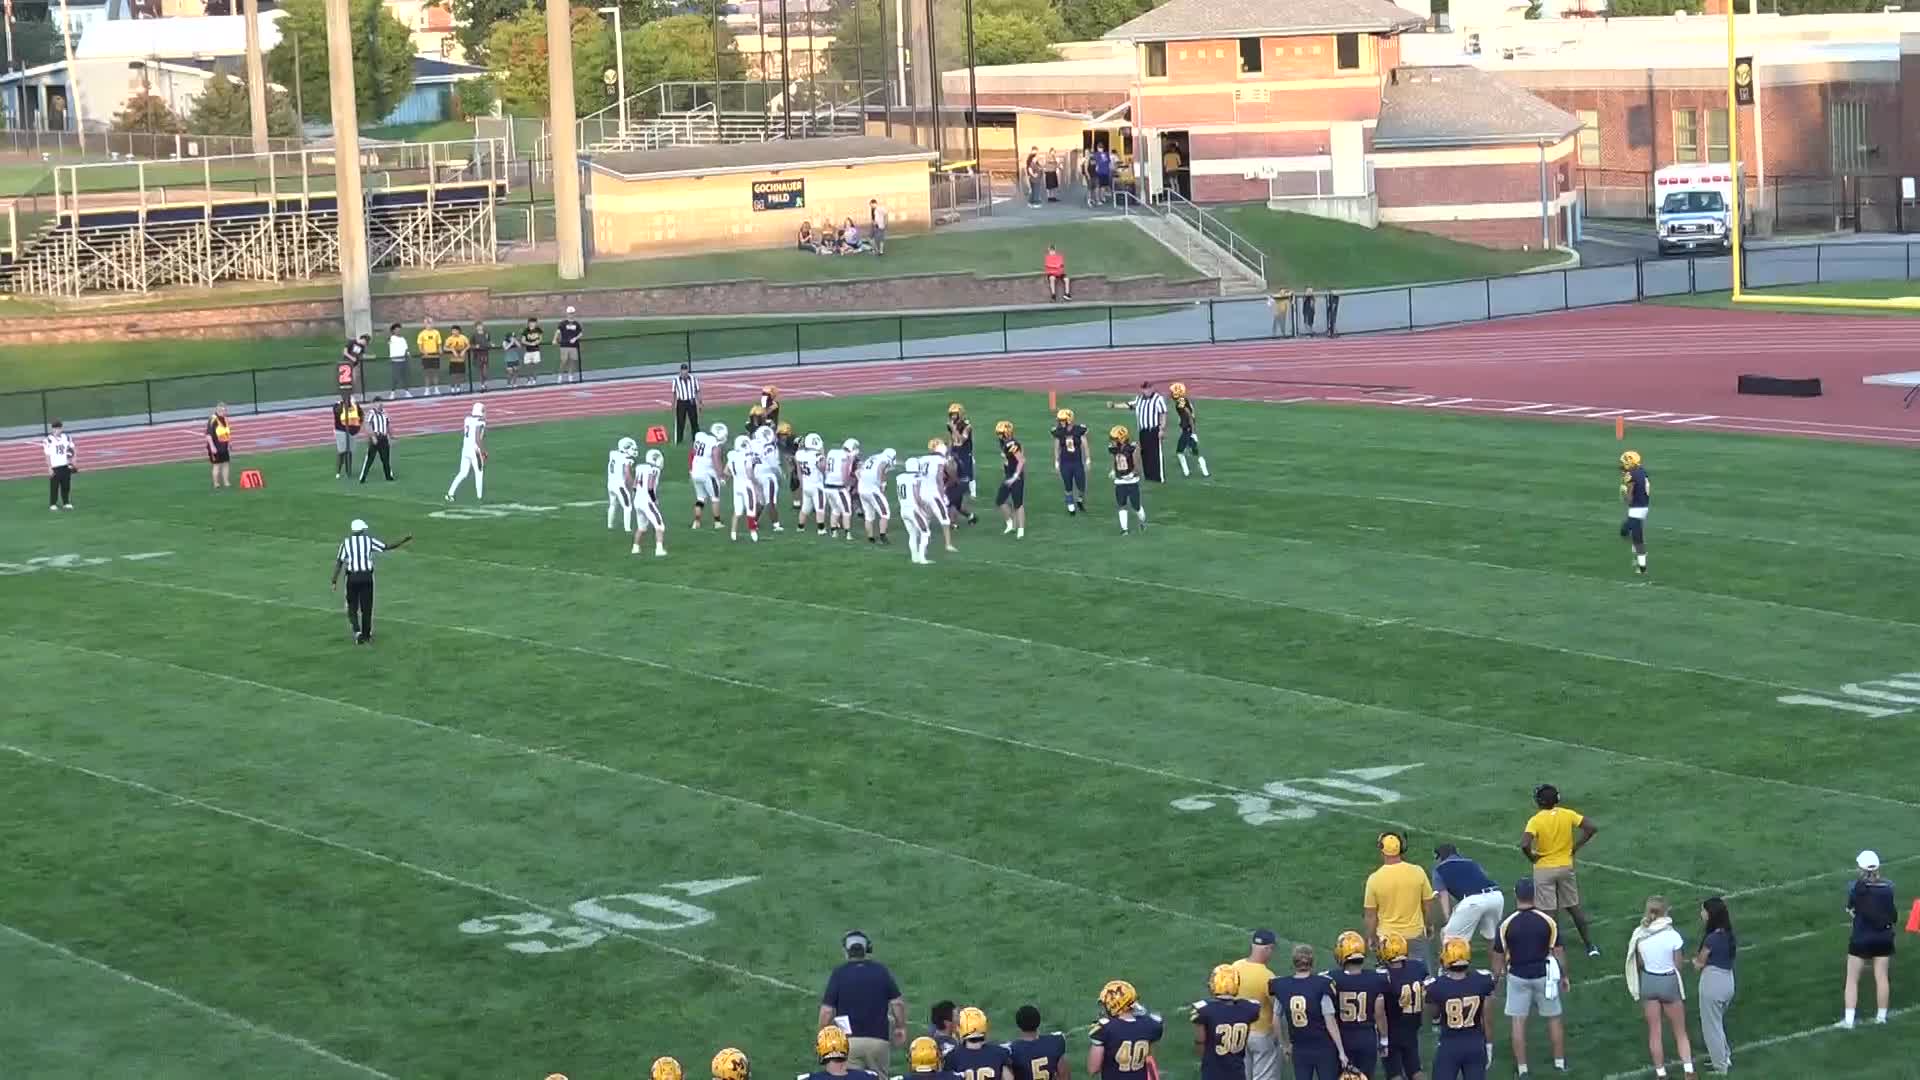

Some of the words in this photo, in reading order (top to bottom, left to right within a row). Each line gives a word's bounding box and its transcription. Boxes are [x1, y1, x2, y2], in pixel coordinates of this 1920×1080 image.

[768, 193, 790, 203] FIELD
[339, 364, 351, 383] 2
[246, 473, 260, 487] 10
[1169, 777, 1402, 826] 20
[458, 892, 716, 954] 30
[1289, 995, 1308, 1027] 8
[1339, 991, 1368, 1023] 51
[1399, 981, 1422, 1014] 41
[1445, 995, 1481, 1028] 87
[1215, 1023, 1249, 1056] 30
[1031, 1056, 1050, 1080] 5
[1115, 1040, 1149, 1072] 40
